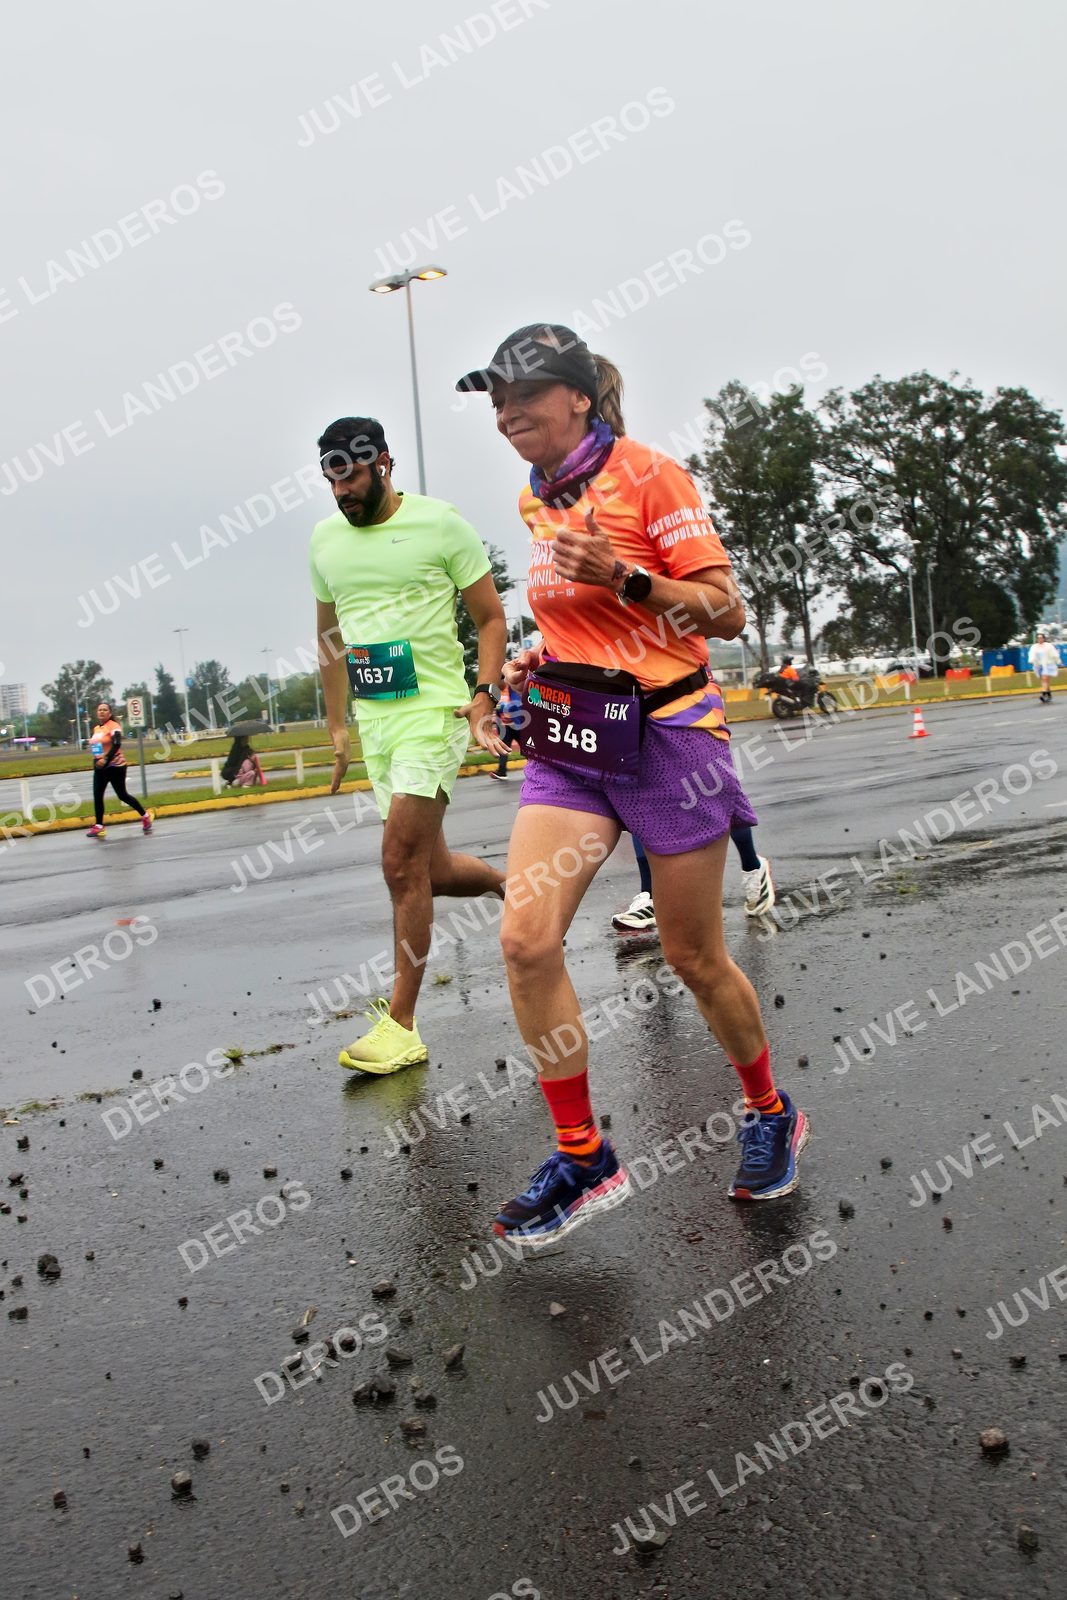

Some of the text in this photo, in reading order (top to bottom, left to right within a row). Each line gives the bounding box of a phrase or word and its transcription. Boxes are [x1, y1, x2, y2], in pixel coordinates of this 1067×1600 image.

[389, 645, 404, 657] 10K
[356, 666, 394, 684] 1637
[604, 702, 630, 721] 15K
[547, 718, 598, 754] 348
